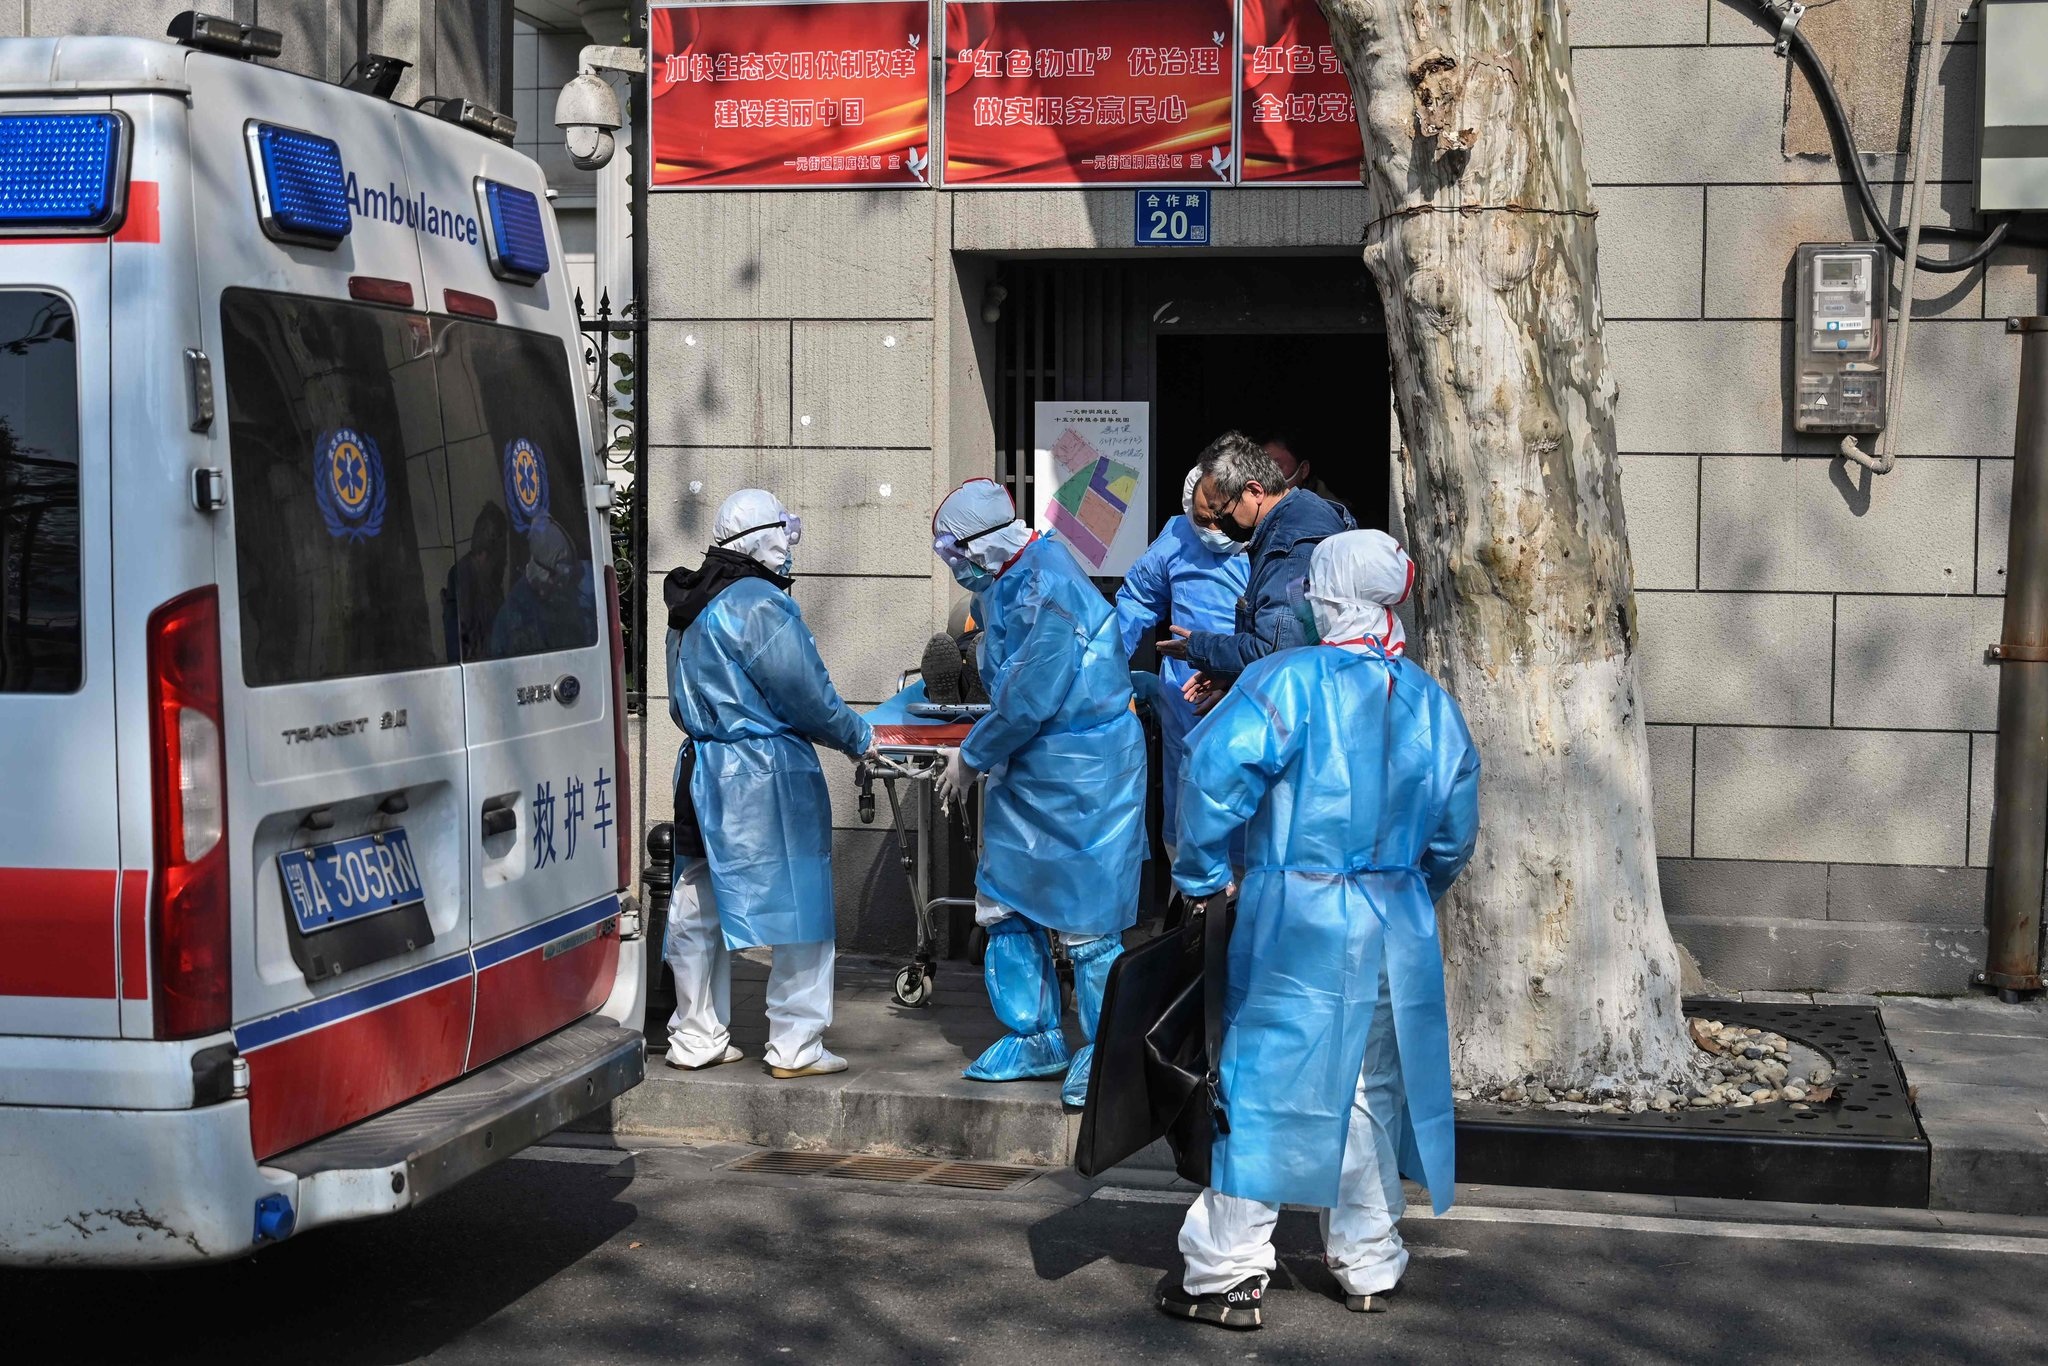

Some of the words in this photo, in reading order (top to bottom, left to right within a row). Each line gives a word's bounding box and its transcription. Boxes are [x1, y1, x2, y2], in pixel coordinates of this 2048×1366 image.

[665, 49, 916, 83] 加快生态文明体制改革
[958, 47, 1111, 78] “红色物业”
[1127, 47, 1220, 76] 优治理
[714, 97, 865, 129] 建设美丽中国
[973, 95, 1188, 126] 做实服务赢民心
[783, 155, 882, 171] 一元街道洞庭社区
[888, 155, 900, 170] 宣
[1081, 154, 1183, 170] 一元街道洞庭社区
[1190, 153, 1203, 169] 宣
[344, 171, 478, 245] Ambulance
[1146, 194, 1200, 208] 合作路
[1150, 210, 1188, 240] 20
[281, 717, 369, 745] TRANSIT
[533, 768, 614, 870] 救护车
